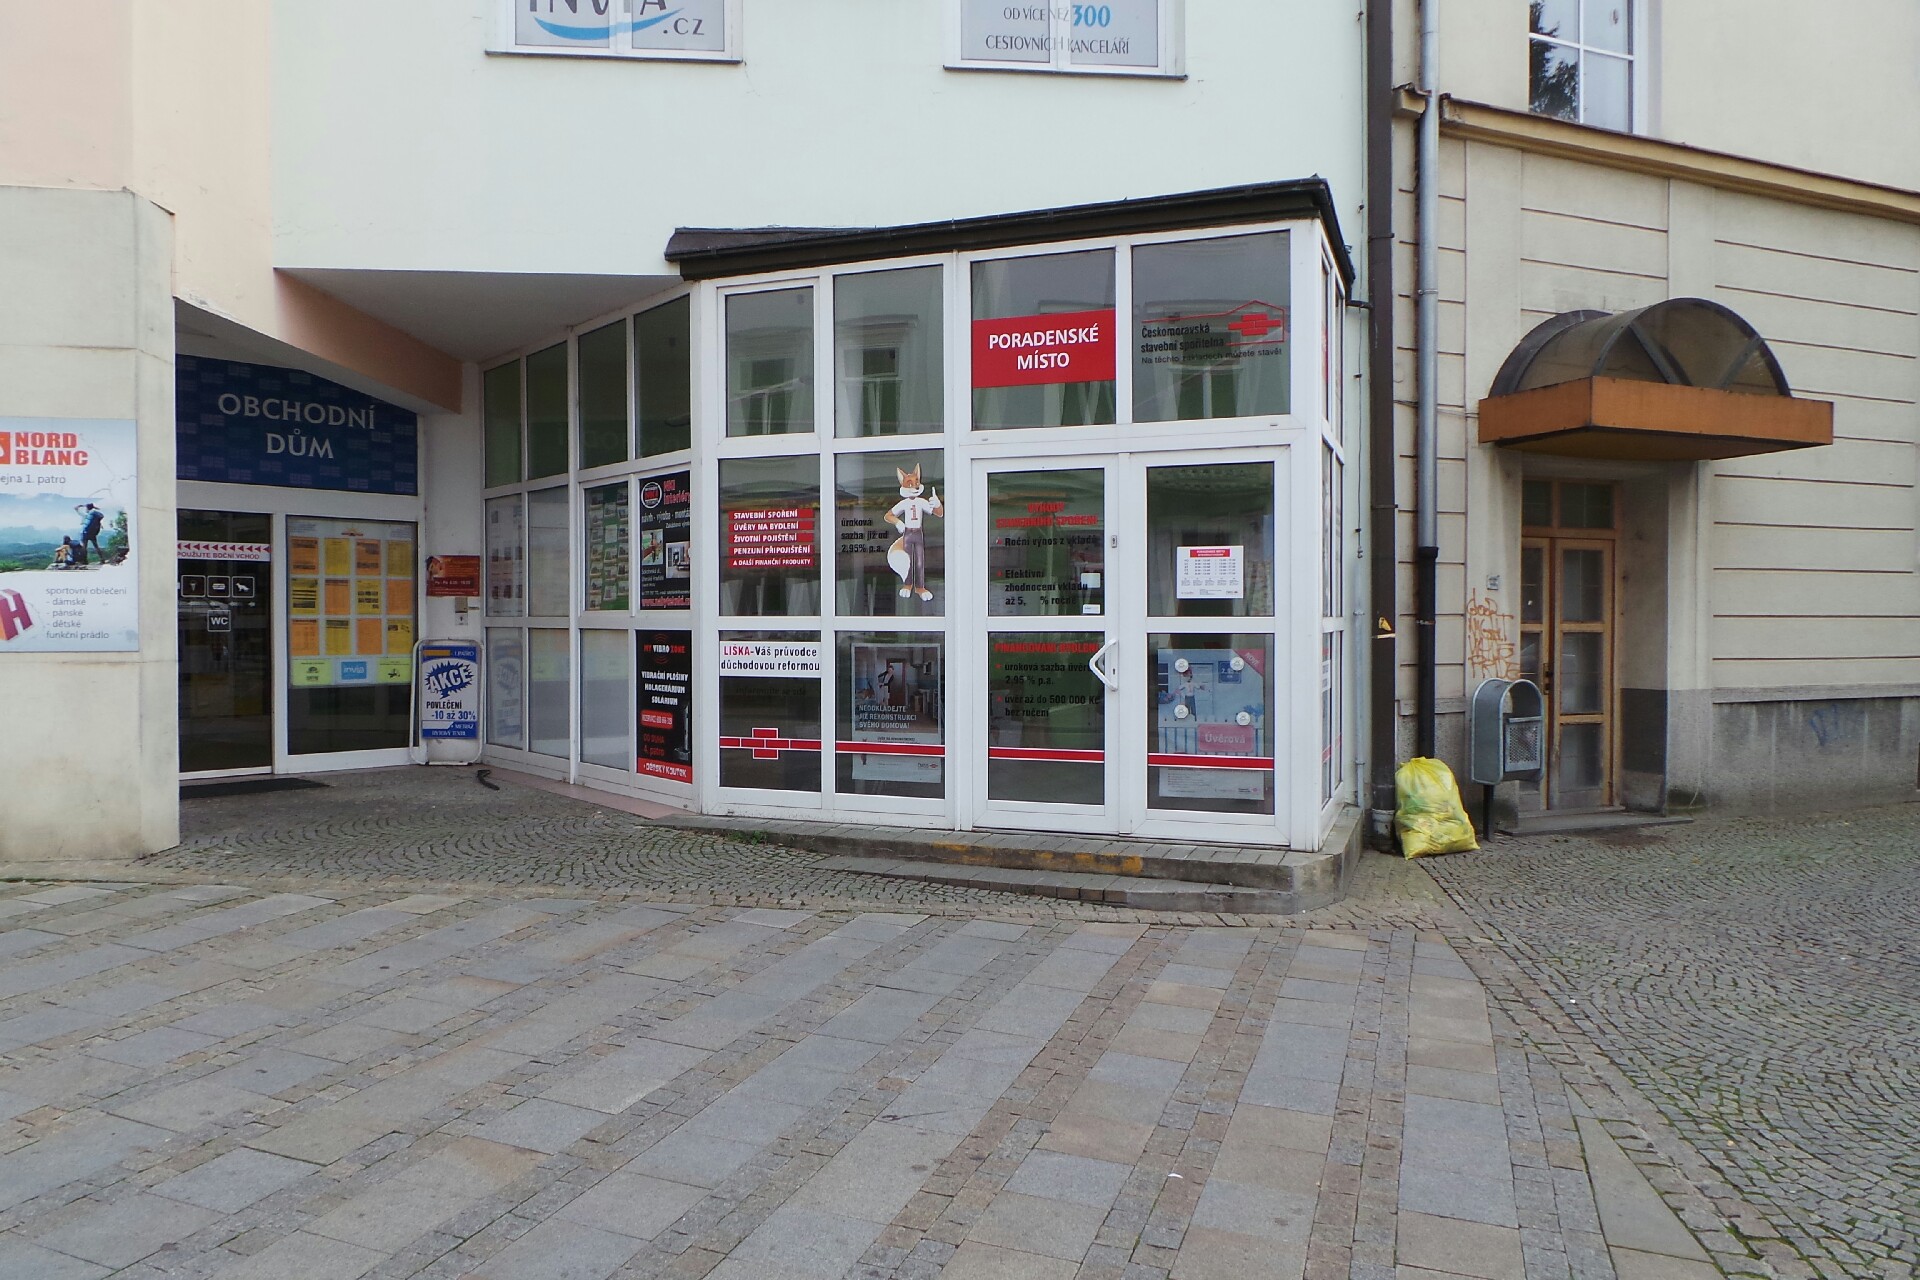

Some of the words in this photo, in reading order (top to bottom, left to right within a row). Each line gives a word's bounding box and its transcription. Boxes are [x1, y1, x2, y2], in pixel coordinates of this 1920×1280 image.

[1003, 7, 1020, 20] OD
[1023, 5, 1046, 21] VÍCE
[1072, 5, 1111, 27] 300
[986, 34, 1064, 51] CESTOVNÍCH
[1068, 37, 1129, 54] KANCELÁŘÍ
[1142, 323, 1210, 338] Českomoravská
[988, 323, 1099, 349] PORADENSKÉ
[1141, 340, 1177, 353] stavební
[1179, 337, 1225, 351] spořitelna
[1017, 351, 1070, 370] MÍSTO
[1155, 355, 1180, 363] těchto
[217, 393, 375, 430] OBCHODNÍ
[15, 432, 77, 449] NORD
[266, 428, 334, 459] DŮM
[15, 449, 89, 466] BLANC
[0, 474, 23, 485] ejna
[37, 475, 66, 485] patro
[733, 510, 766, 520] STAVEBNÍ
[768, 509, 798, 519] SPOŘENÍ
[733, 522, 756, 531] ÚVĚRY
[769, 521, 799, 530] BYDLENÍ
[841, 517, 873, 527] úroková
[733, 534, 761, 543] ŽIVOTNÍ
[762, 533, 797, 542] POJIŠTĚNÍ
[841, 531, 864, 540] sazba
[867, 531, 878, 541] již
[878, 531, 889, 539] od
[1005, 537, 1030, 546] Roční
[1032, 537, 1057, 547] výnos
[733, 546, 764, 555] PENZIJNÍ
[765, 545, 811, 554] PŘIPOJIŠTĚNÍ
[755, 558, 781, 566] FINANČNÍ
[1005, 569, 1044, 579] Efektivní
[46, 587, 88, 596] sportovní
[90, 587, 127, 595] oblečení
[1005, 582, 1056, 592] zhodnocení
[52, 598, 87, 606] dámské
[1005, 596, 1016, 605] až
[52, 609, 84, 618] pánské
[52, 620, 81, 628] dětské
[210, 617, 228, 625] WC
[46, 631, 79, 639] funkční
[80, 631, 110, 640] prádlo
[774, 646, 817, 659] průvodce
[721, 659, 775, 670] důchodovou
[778, 660, 820, 671] reformou
[1005, 662, 1039, 671] úroková
[1040, 663, 1065, 672] sazba
[428, 664, 471, 693] AKCE
[641, 670, 666, 680] VIBRAČNÍ
[426, 699, 462, 710] POVLEČENÍ
[651, 695, 678, 706] SOLÁRIUM
[1024, 695, 1034, 704] až
[1036, 696, 1047, 704] do
[431, 711, 444, 720] -10
[446, 710, 456, 720] až
[458, 711, 476, 720] 30%
[869, 713, 917, 721] REKONSTRUKCI
[1005, 707, 1021, 717] bez
[1022, 707, 1050, 717] ručení
[859, 720, 880, 729] SVÉHO
[1205, 731, 1246, 744] Úvěrová
